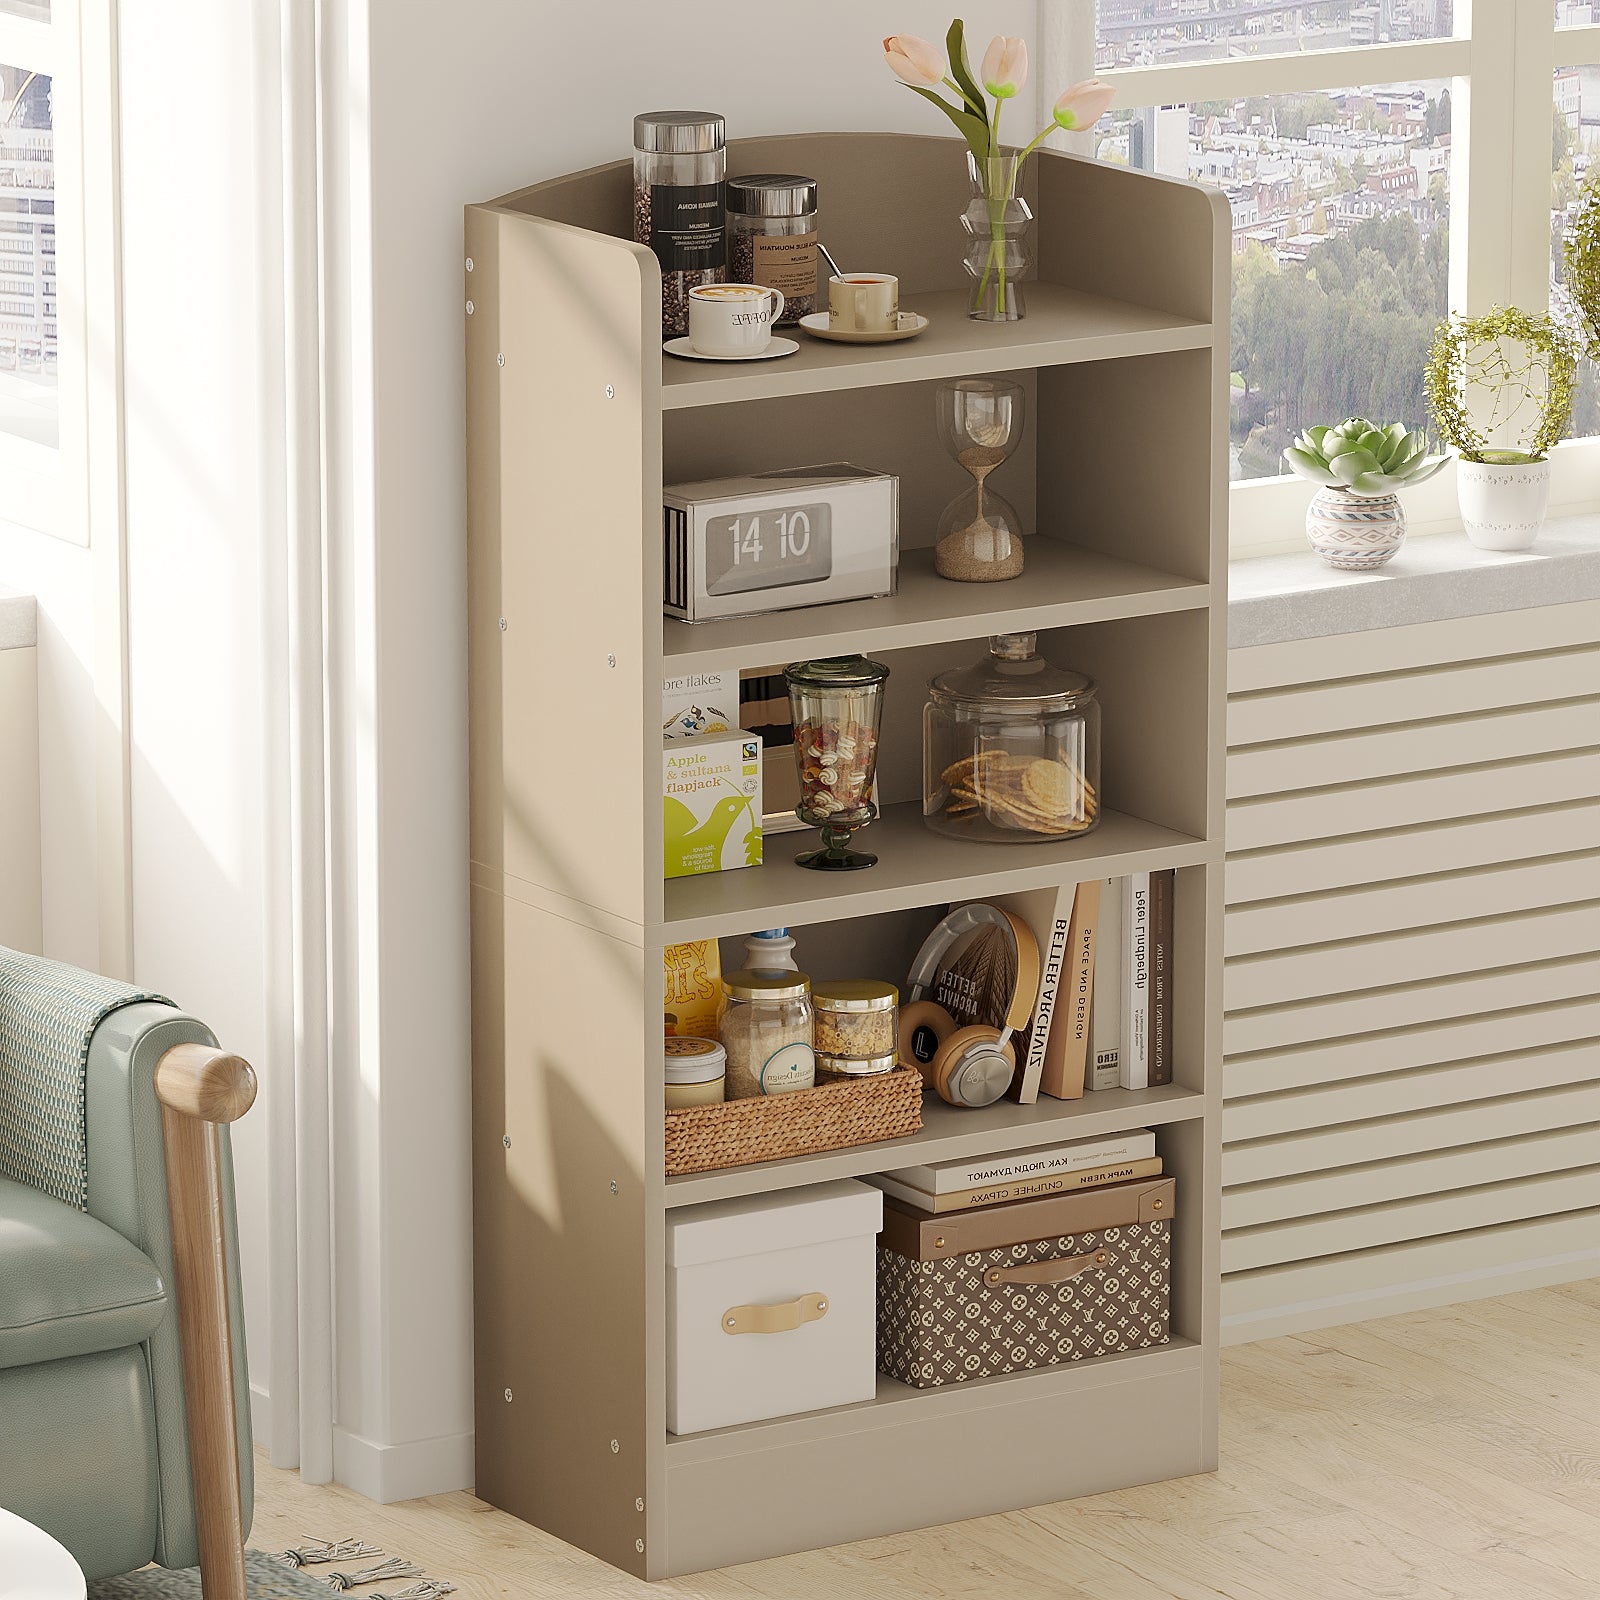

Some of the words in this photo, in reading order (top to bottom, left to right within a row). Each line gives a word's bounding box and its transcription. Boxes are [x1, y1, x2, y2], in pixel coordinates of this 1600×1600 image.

[728, 516, 764, 565] 14
[774, 511, 810, 558] 10
[686, 674, 720, 688] flakes
[666, 754, 707, 768] Apple
[667, 770, 678, 780] &
[681, 764, 732, 778] sultana
[666, 778, 721, 794] flapjack
[916, 1031, 929, 1059] L
